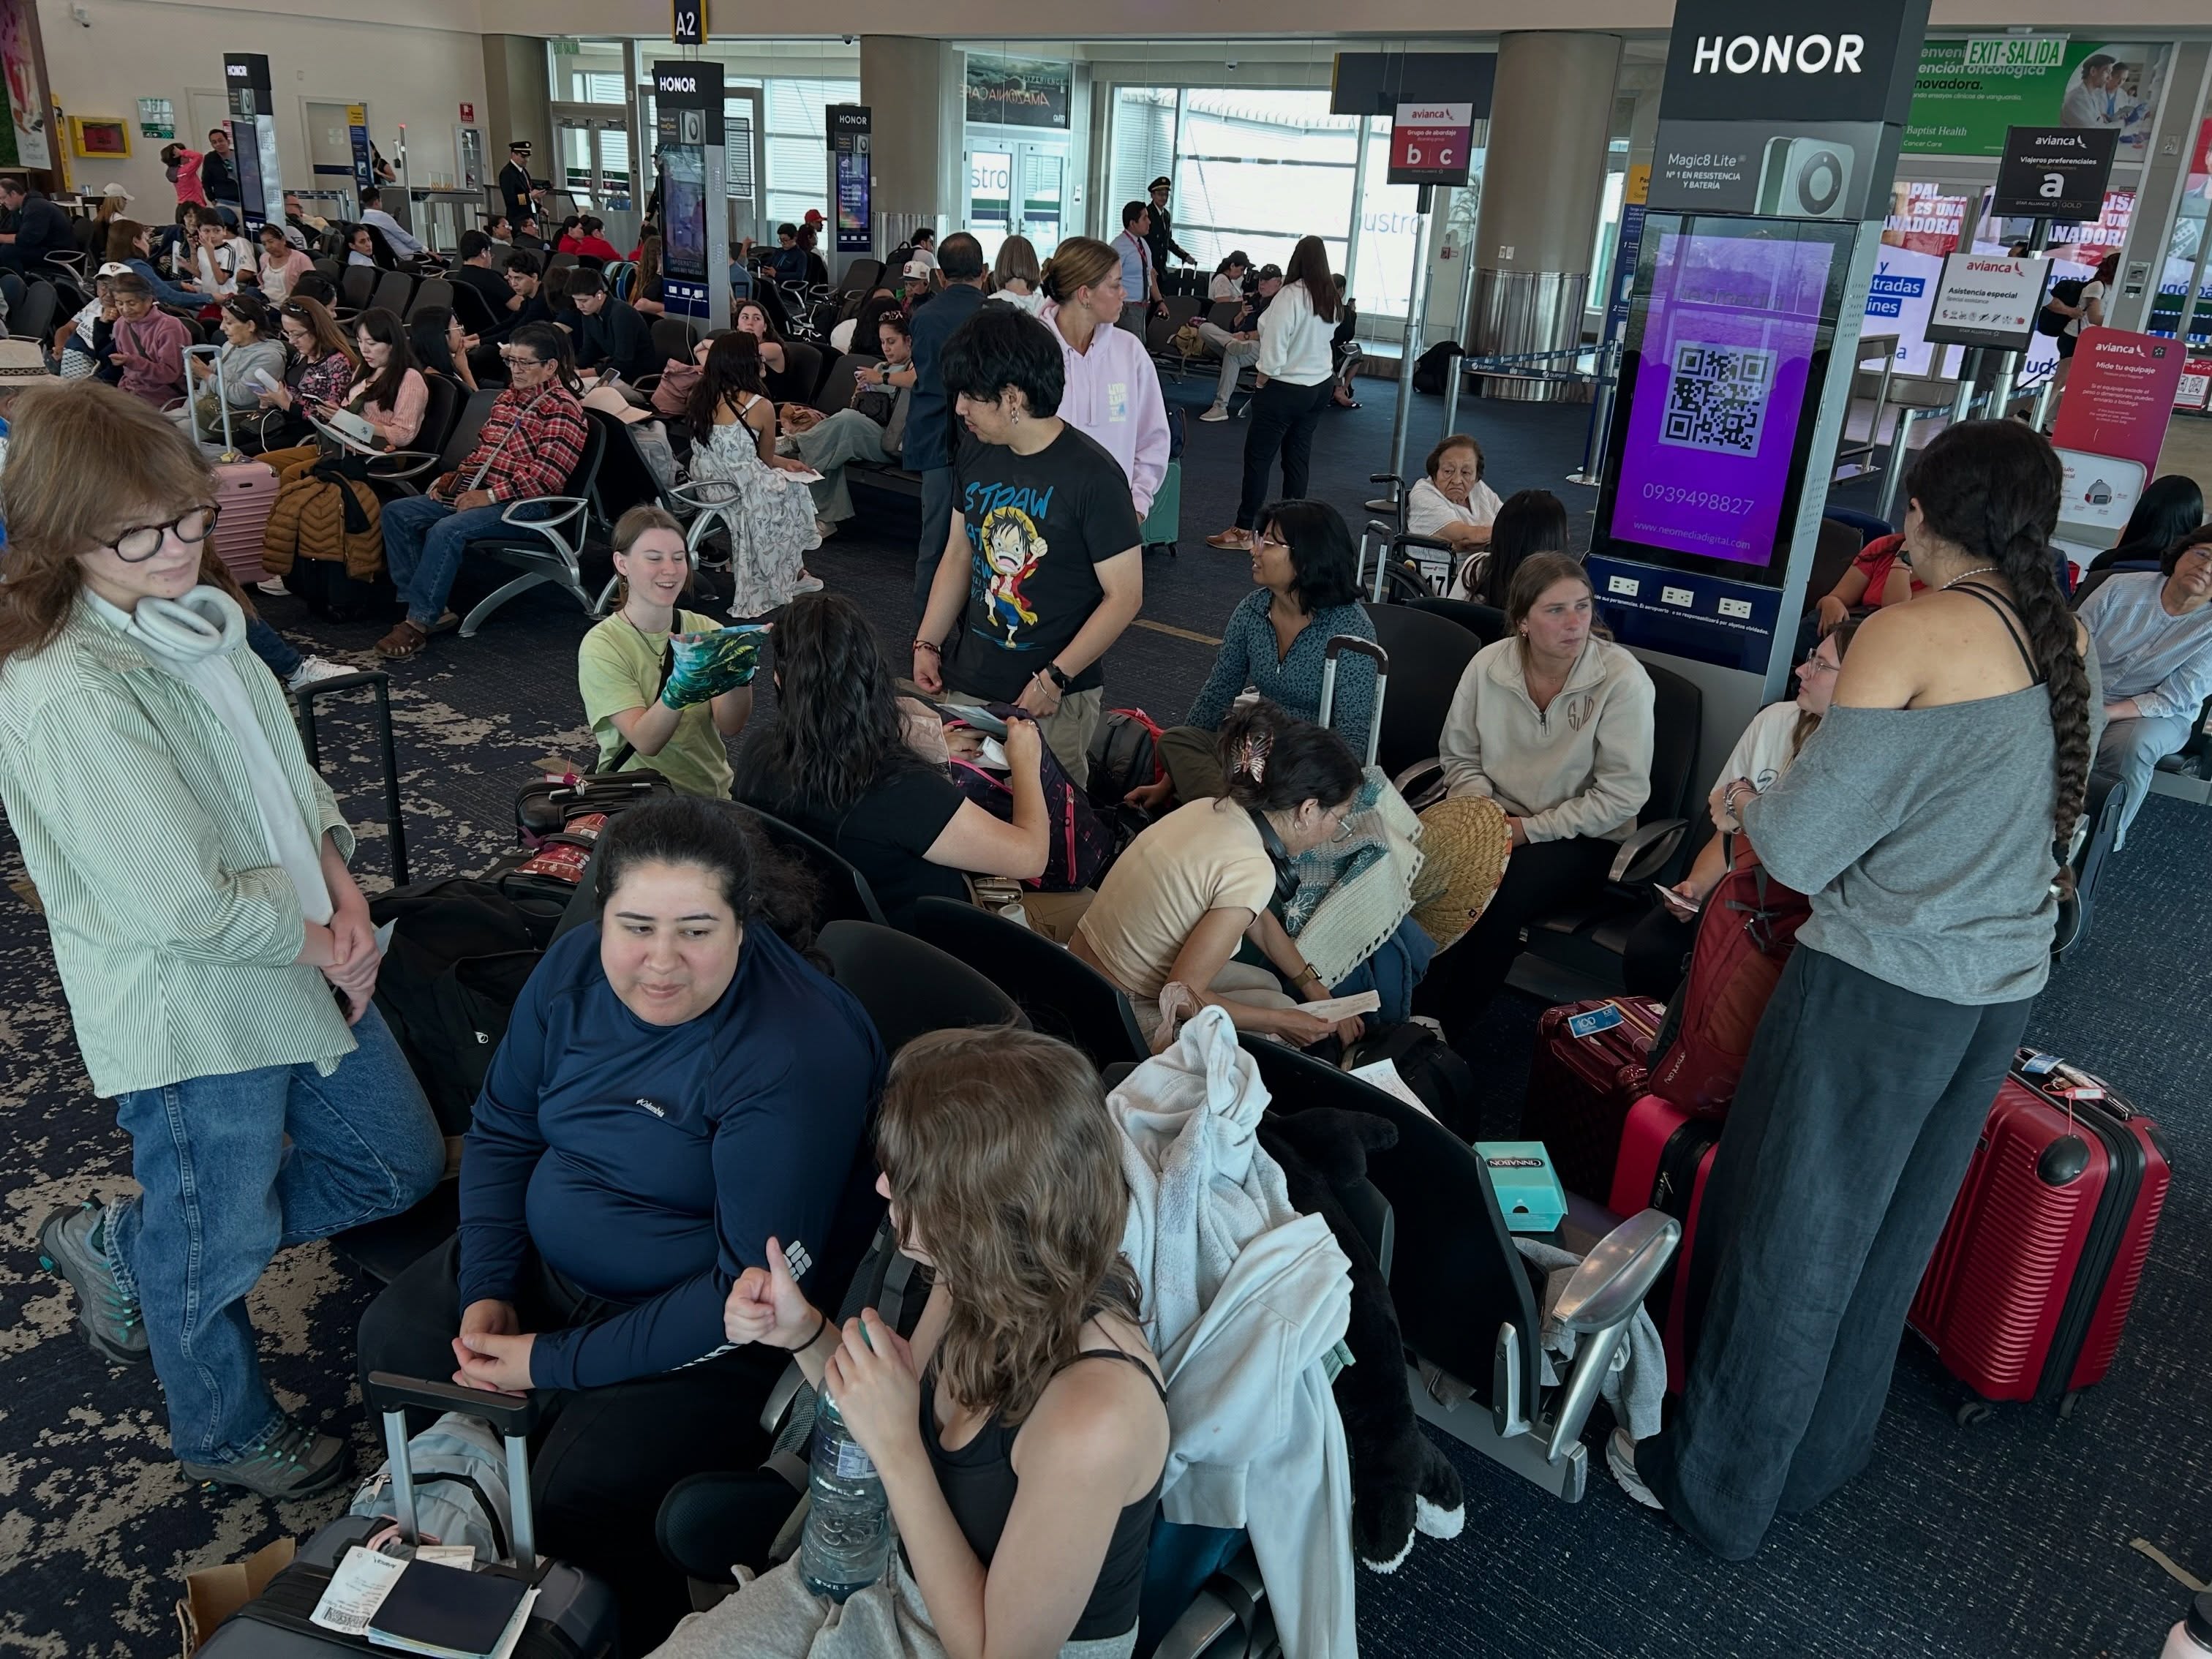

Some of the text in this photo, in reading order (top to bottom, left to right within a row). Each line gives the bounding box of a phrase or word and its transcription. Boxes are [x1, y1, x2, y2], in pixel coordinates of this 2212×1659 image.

[676, 12, 695, 35] A2
[1693, 34, 1865, 73] HONOR
[1968, 41, 2060, 64] EXIT-SALIDA
[227, 65, 247, 76] HONOR
[660, 76, 696, 92] HONOR
[1023, 75, 1064, 86] EXPERIENCE
[840, 115, 867, 125] HONOR
[1412, 108, 1444, 118] avianca
[1906, 125, 1967, 137] Baptist Health
[2036, 135, 2075, 146] avianca
[1407, 143, 1453, 165] b c
[1668, 153, 1710, 168] Magic8
[1714, 154, 1737, 167] Lite
[2048, 157, 2097, 165] preferenciales
[1677, 172, 1680, 180] 1
[1682, 172, 1693, 180] EN
[1693, 172, 1740, 181] RESISTENCIA
[1689, 181, 1720, 189] BATERÍA
[2039, 173, 2065, 198] a
[1914, 202, 1964, 217] ES UNA
[1967, 260, 2012, 273] avianca
[1870, 278, 1920, 293] tradas
[1949, 287, 2018, 299] Asistencia especial
[2095, 342, 2134, 354] avianca
[2096, 361, 2114, 370] Mide
[2124, 365, 2156, 375] equipaje
[965, 481, 1054, 520] STRAW
[1642, 482, 1755, 516] 0939498827
[1633, 520, 1751, 550] www.neomediadigital.com
[1426, 575, 1445, 596] 17
[1609, 597, 1639, 608] pertenencias.
[1644, 605, 1669, 614] aeropuerto
[1728, 622, 1745, 631] objetos
[1745, 625, 1769, 635] olvidados.
[1576, 1016, 1596, 1029] 100
